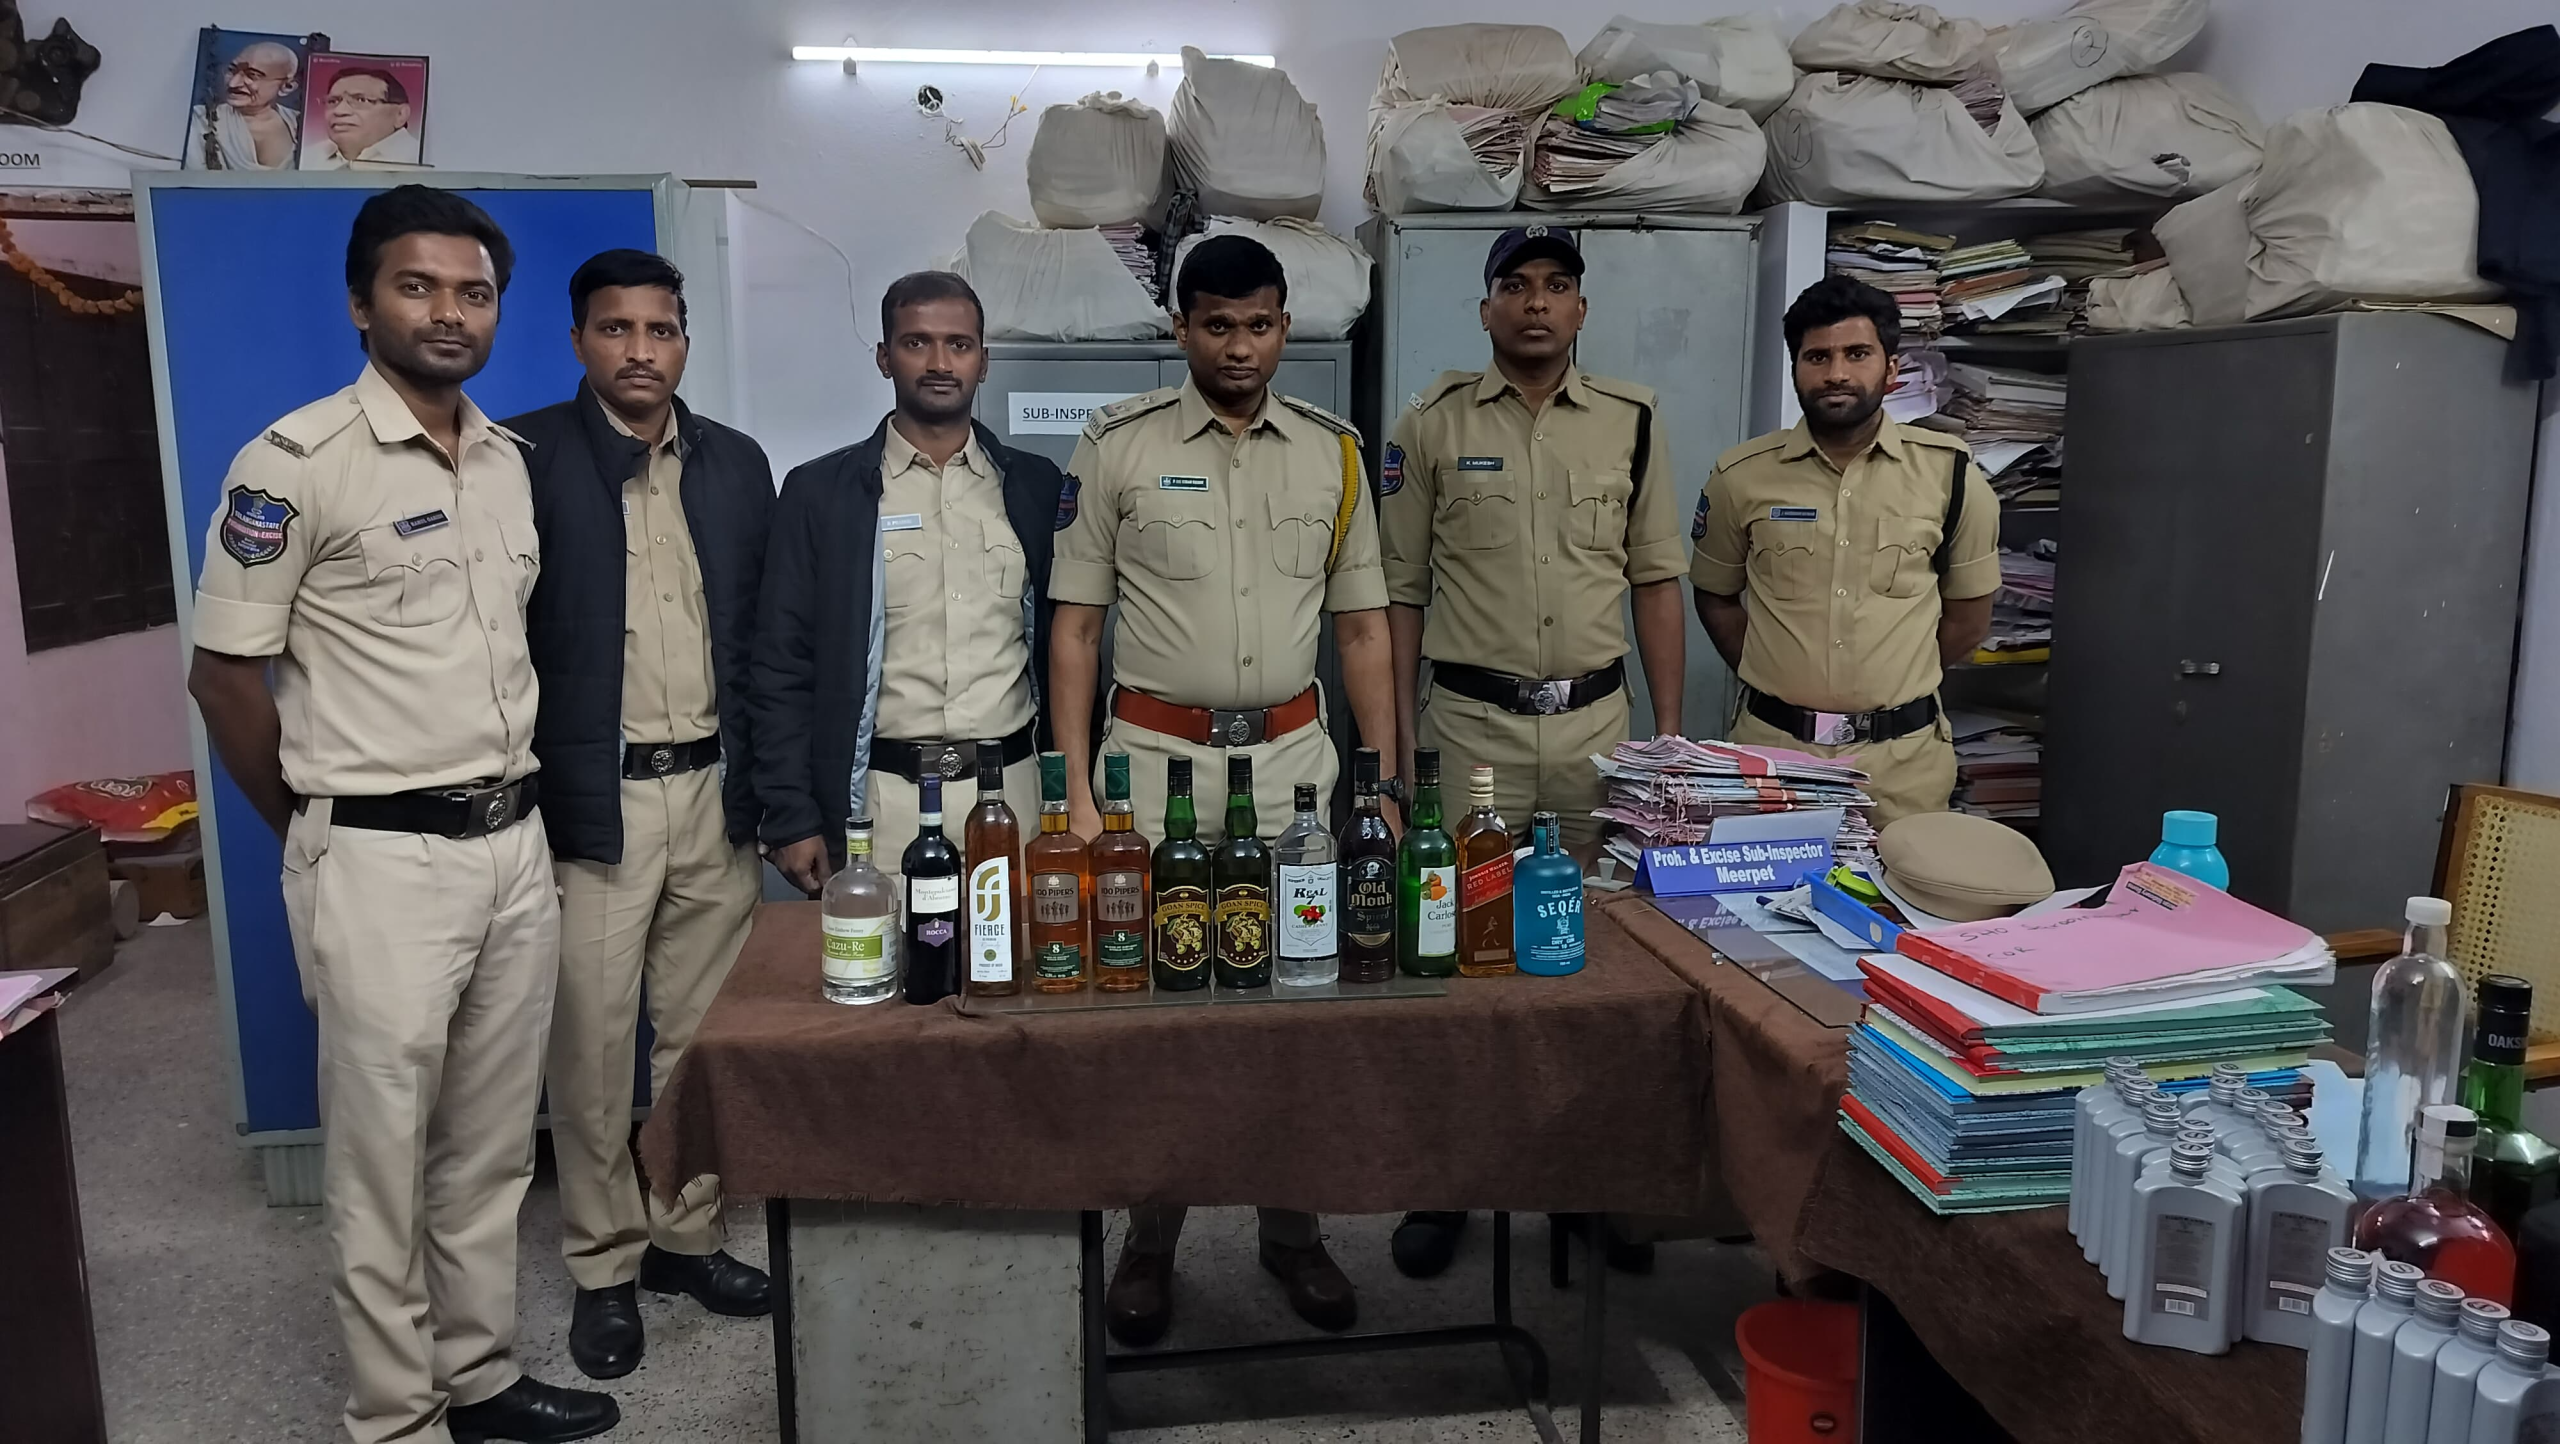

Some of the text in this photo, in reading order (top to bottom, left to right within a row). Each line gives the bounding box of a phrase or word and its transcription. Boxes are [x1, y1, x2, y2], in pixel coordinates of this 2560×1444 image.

[1652, 843, 1824, 867] Proh. & Excise Sub-Inspector
[1466, 866, 1513, 890] RED LABEL
[1716, 864, 1776, 886] Meerpet
[1048, 887, 1074, 896] PIPERS
[1114, 886, 1140, 895] PIPERS
[1358, 881, 1386, 894] Old
[1221, 900, 1242, 909] GOAN
[1306, 895, 1315, 905] 7
[1351, 892, 1393, 907] Monk
[1436, 898, 1454, 909] Jack
[1161, 903, 1184, 912] GOAN
[974, 924, 1005, 936] FIERCE
[1118, 932, 1126, 942] 8
[1052, 944, 1060, 954] 8
